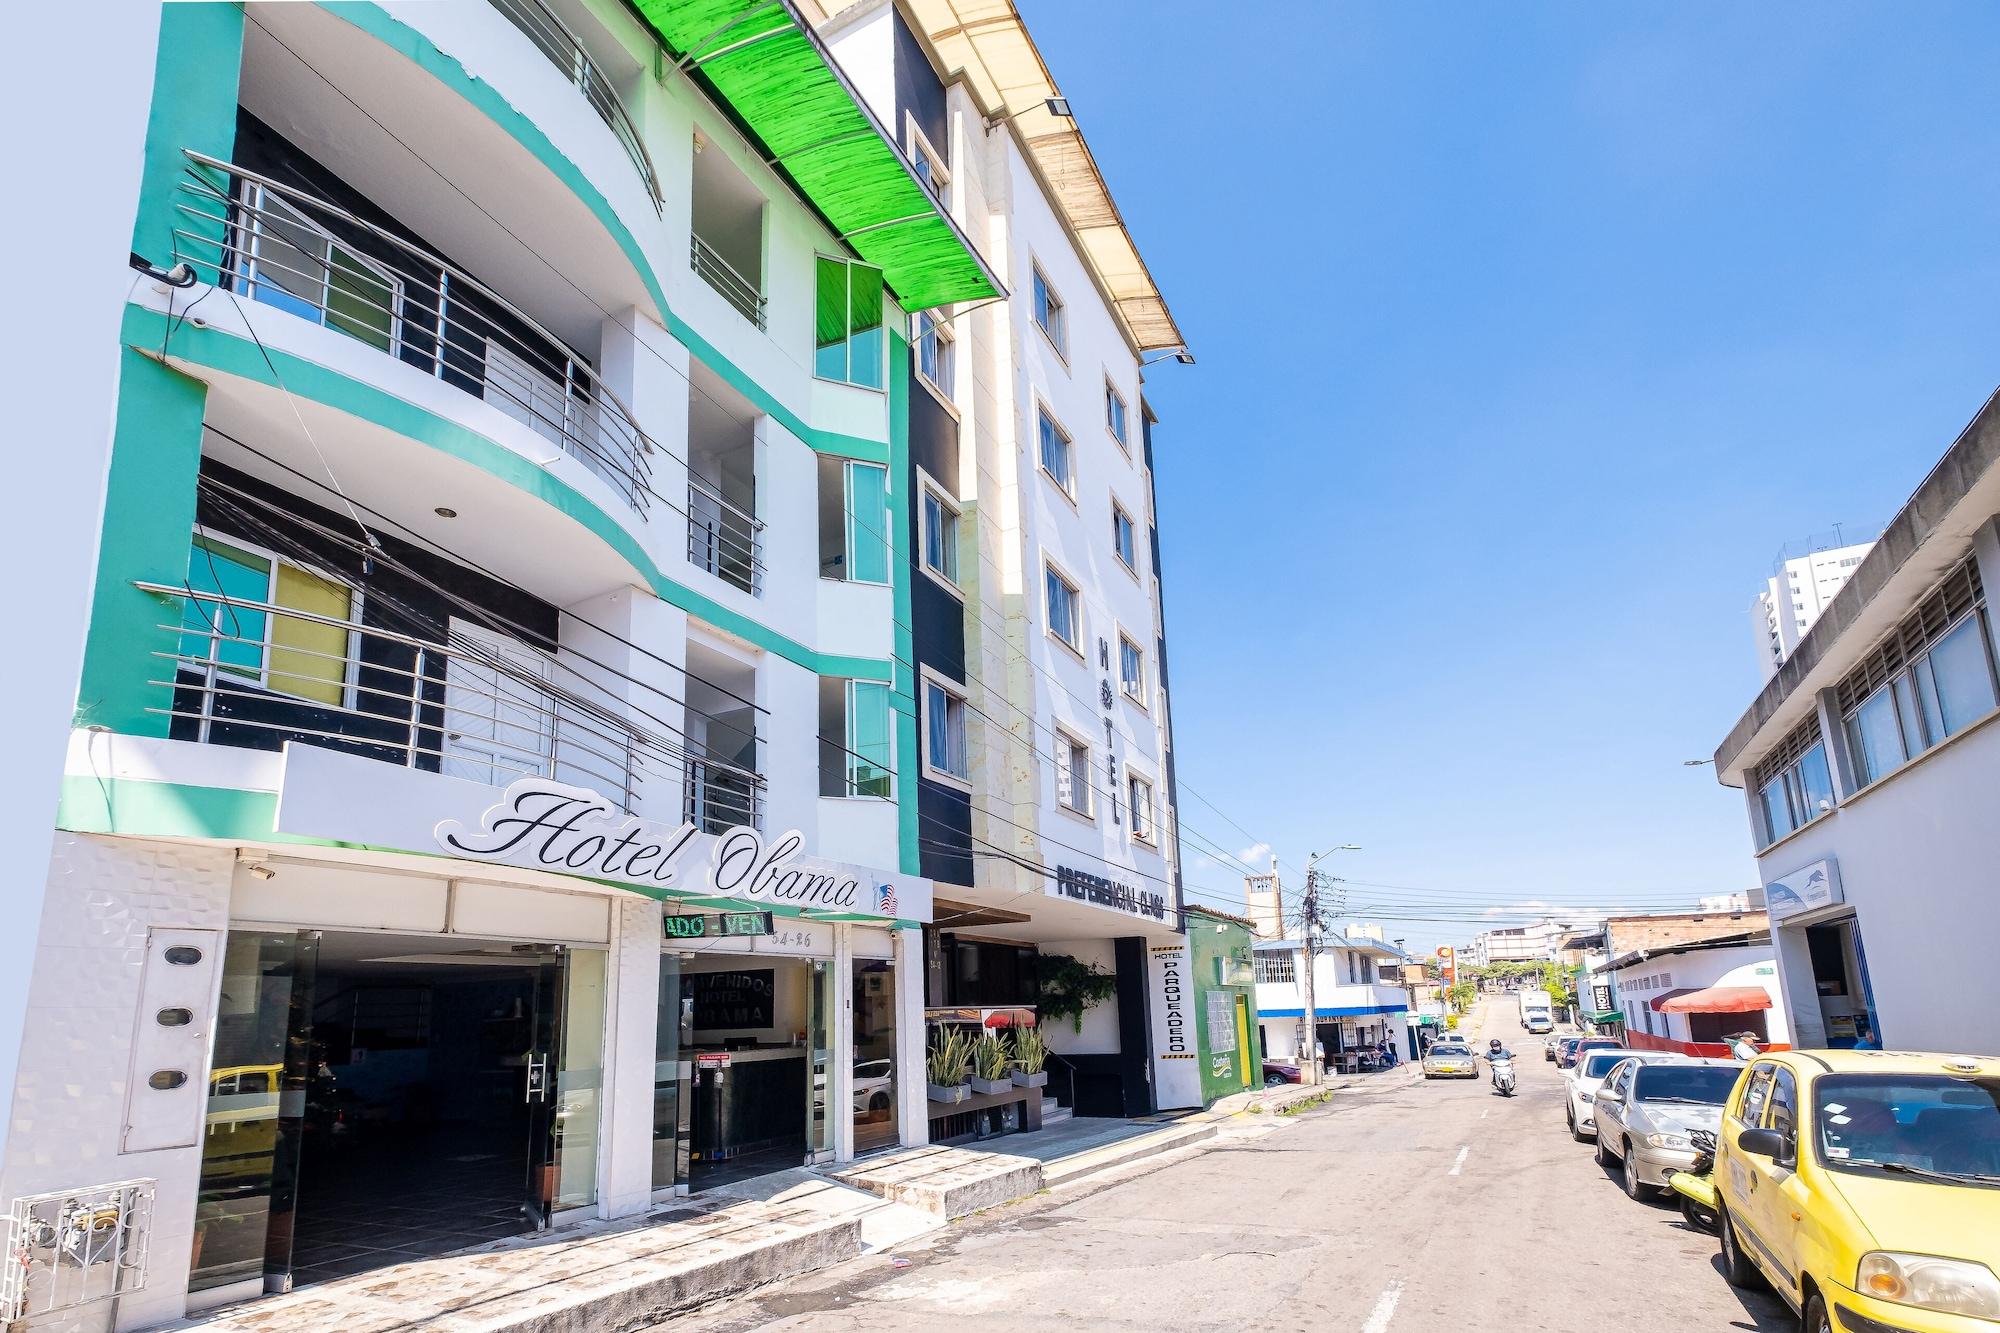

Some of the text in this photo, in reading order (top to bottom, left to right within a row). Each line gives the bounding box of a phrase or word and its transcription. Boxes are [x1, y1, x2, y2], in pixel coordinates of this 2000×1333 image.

[1099, 636, 1121, 826] HOTEL
[447, 791, 859, 907] Hotel Obama
[1057, 864, 1164, 920] PREFERENCIAL CLASS
[1164, 962, 1185, 1052] PARQUEADERO
[1595, 987, 1608, 1010] HOTEL
